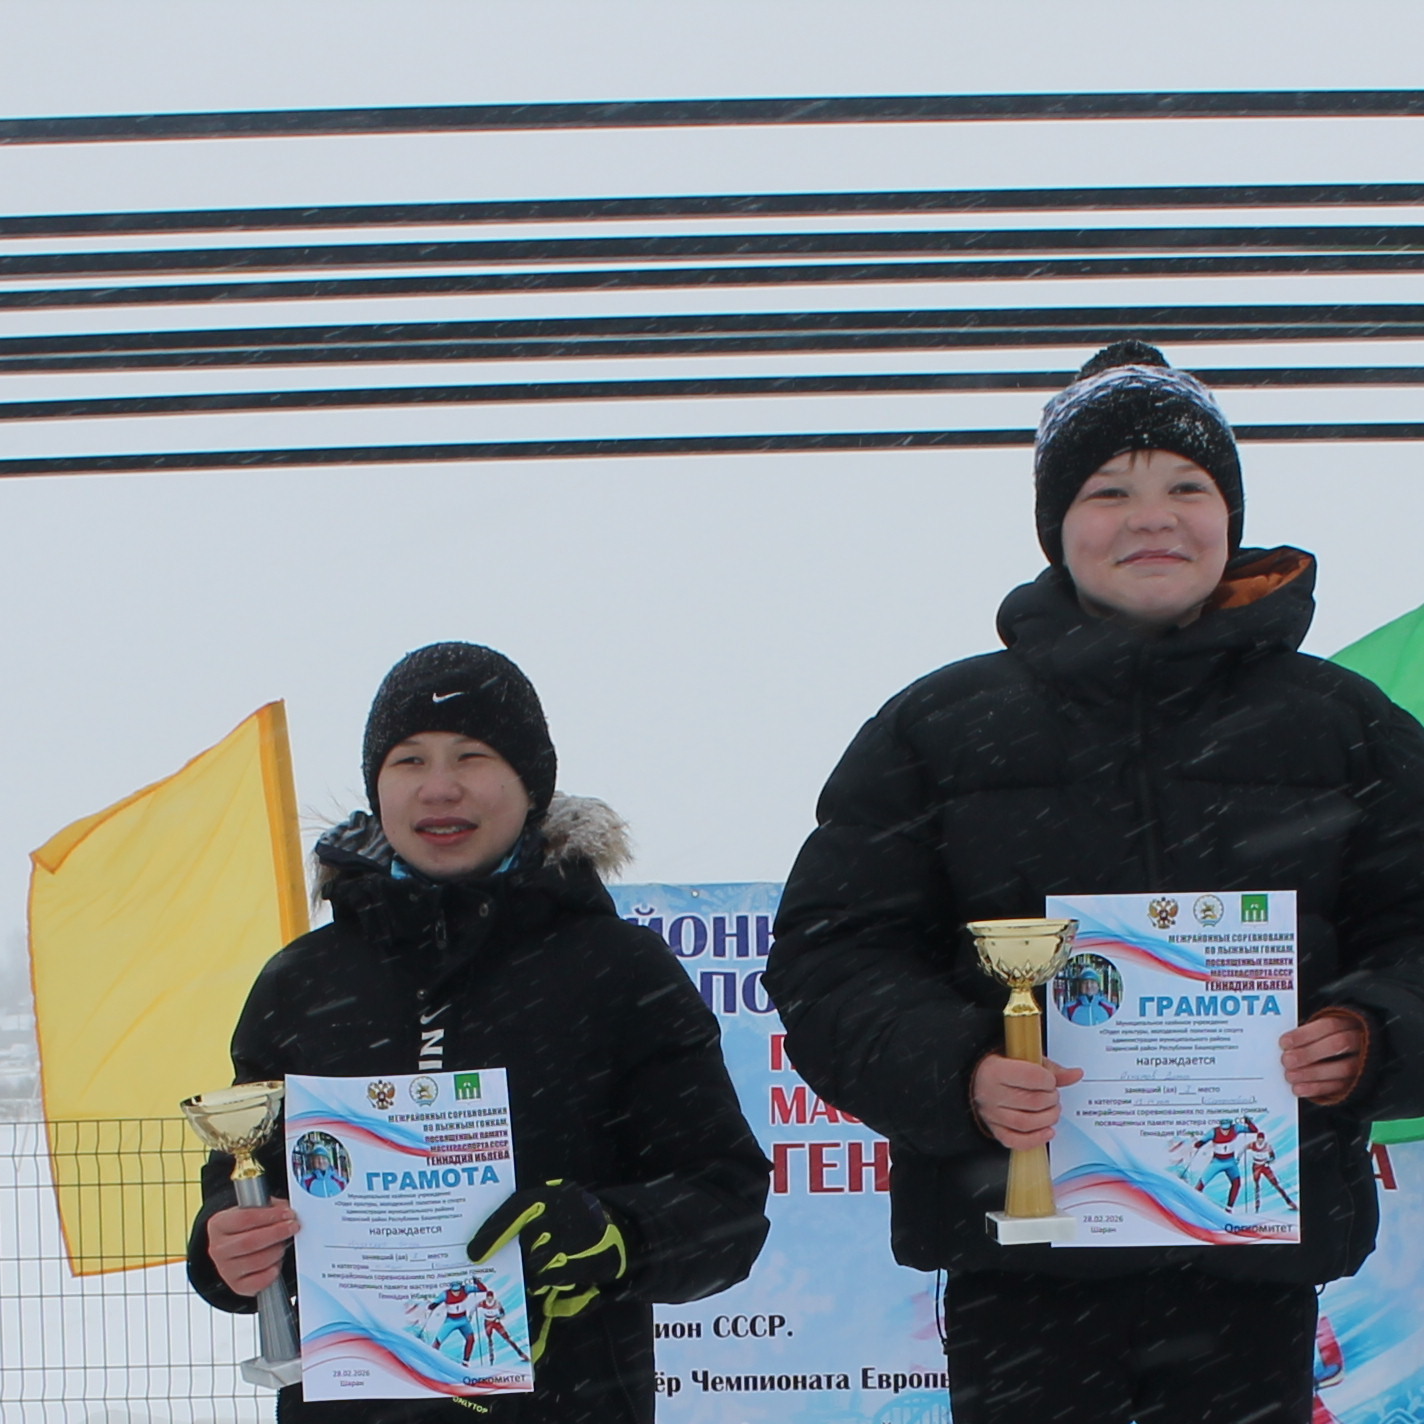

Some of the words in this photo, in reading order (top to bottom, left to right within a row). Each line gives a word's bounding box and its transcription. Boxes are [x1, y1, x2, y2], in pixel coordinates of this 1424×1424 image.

[1168, 933, 1231, 943] МЕЖРАЙОННЫЕ
[1231, 932, 1294, 942] СОРЕВНОВАНИЯ
[1204, 946, 1215, 954] ПО
[1217, 945, 1259, 953] ЛЫЖНЫМ
[1205, 981, 1254, 992] ГЕННАДИЯ
[1256, 980, 1293, 990] ИБЯЕВА
[1139, 995, 1281, 1017] ГРАМОТА
[1136, 1056, 1216, 1066] награждается
[387, 1110, 446, 1122] МЕЖРАЙОННЫЕ
[447, 1106, 507, 1119] СОРЕВНОВАНИЯ
[426, 1153, 473, 1166] ГЕННАДИЯ
[366, 1165, 500, 1191] ГРАМОТА
[1083, 1215, 1123, 1223] 28.02.2026
[369, 1224, 442, 1237] награждается
[1224, 1222, 1292, 1234] Оргкомитет
[713, 1315, 793, 1338] СССР.
[692, 1370, 850, 1393] Чемпионата
